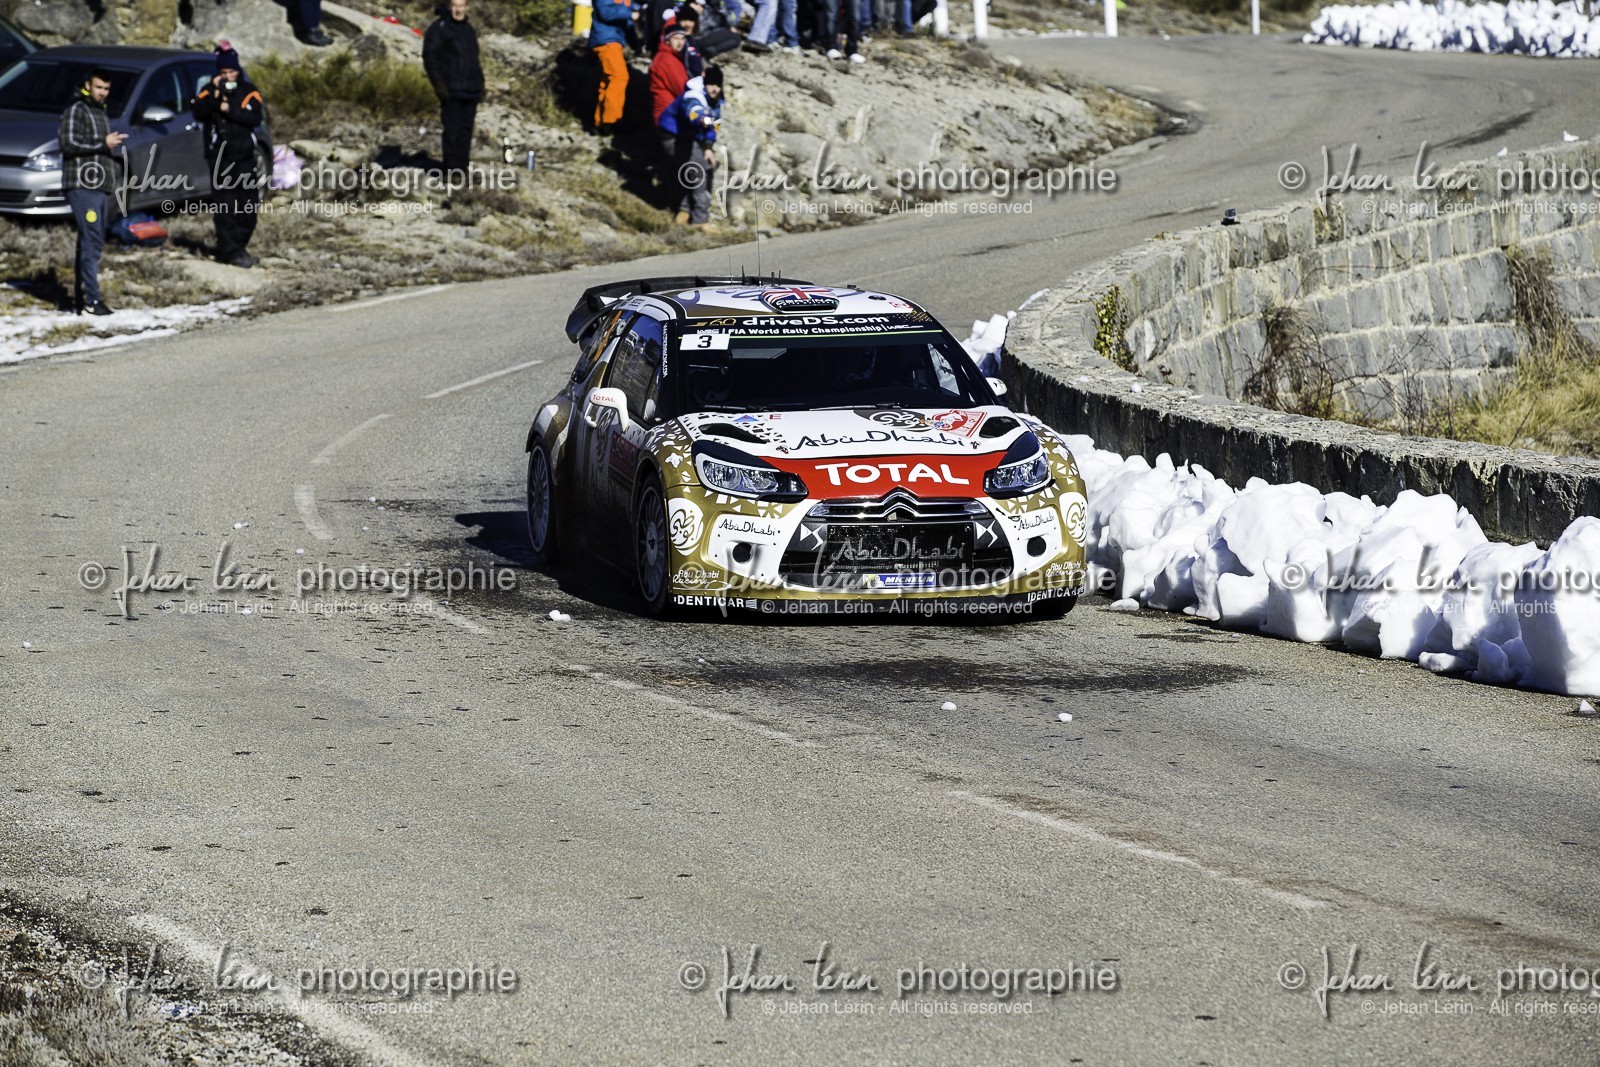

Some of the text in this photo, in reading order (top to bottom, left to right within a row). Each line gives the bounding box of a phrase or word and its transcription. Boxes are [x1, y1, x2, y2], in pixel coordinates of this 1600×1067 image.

[742, 316, 889, 326] driveDS.com
[783, 328, 809, 336] Rally
[811, 324, 882, 335] Championship
[697, 335, 713, 348] 3
[593, 394, 616, 403] TOTAL
[815, 462, 970, 486] TOTAL
[678, 569, 720, 579] Abu Dhabi
